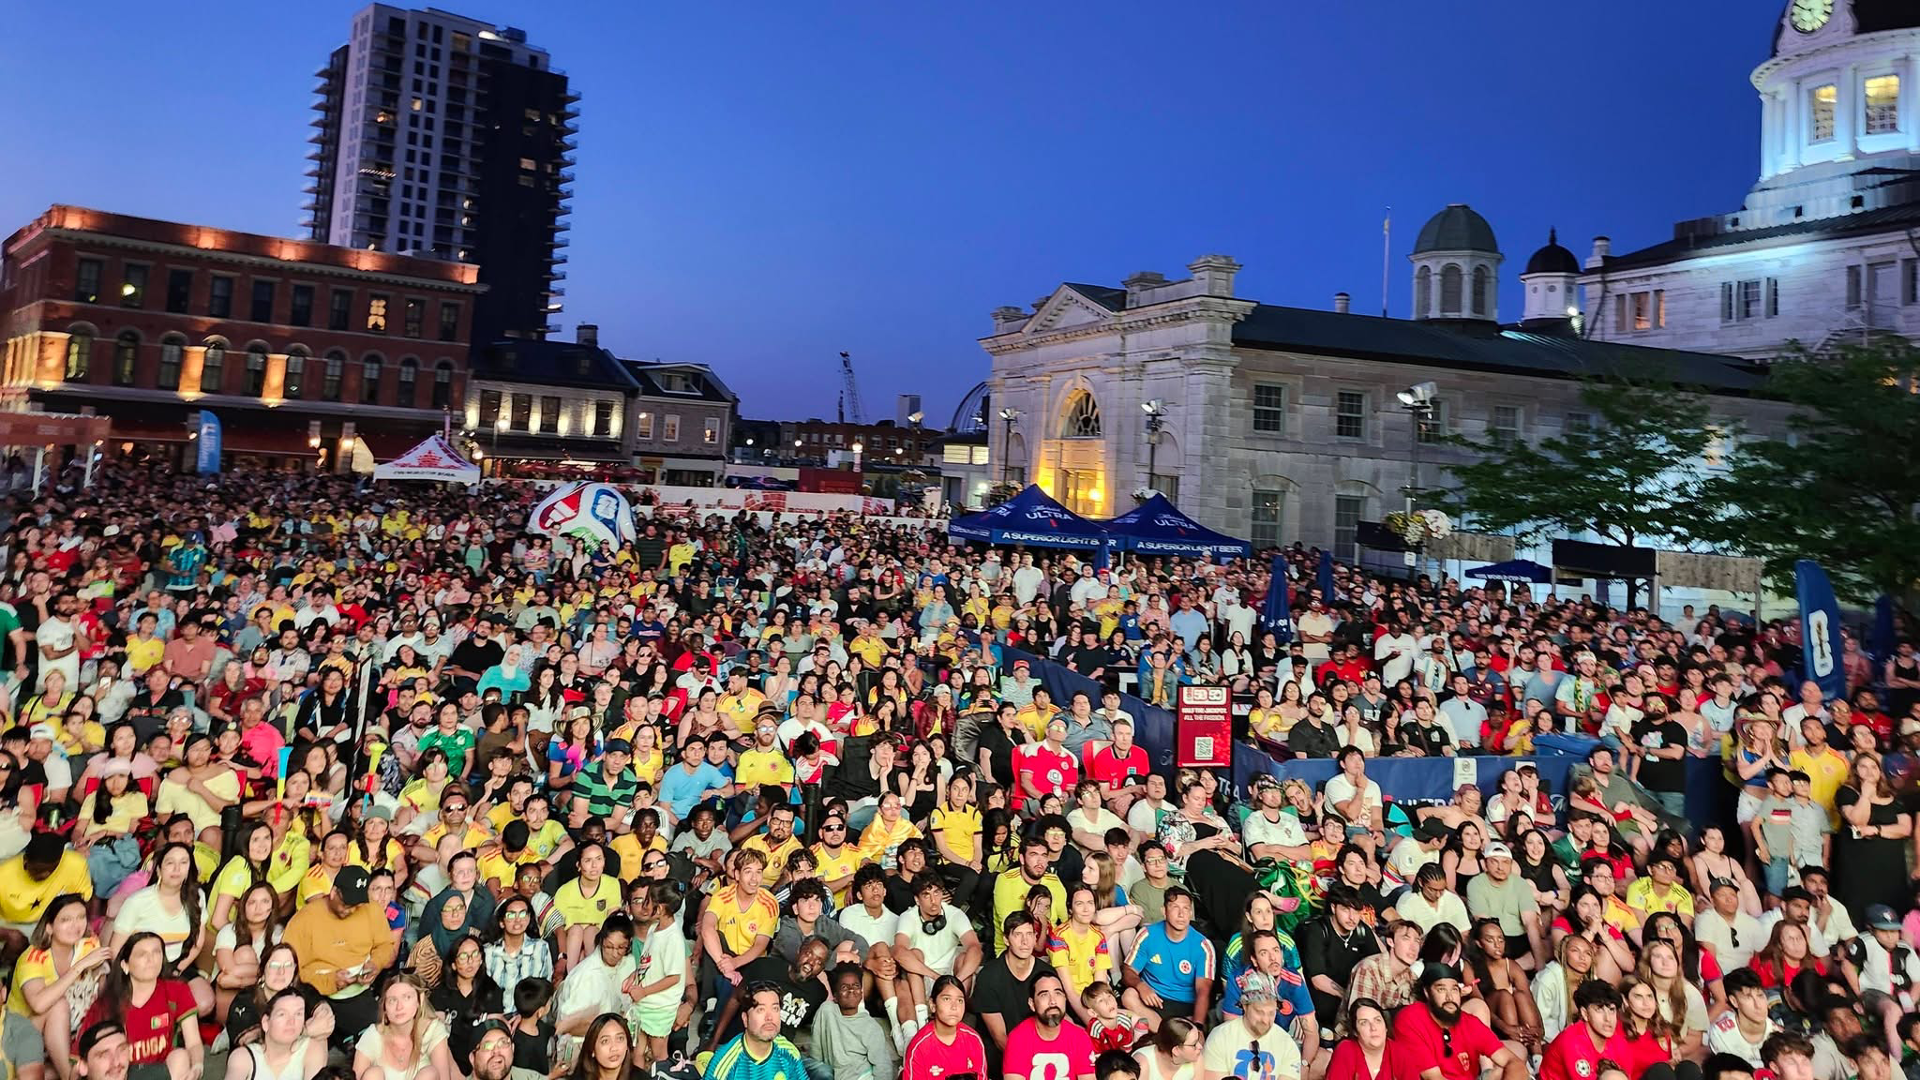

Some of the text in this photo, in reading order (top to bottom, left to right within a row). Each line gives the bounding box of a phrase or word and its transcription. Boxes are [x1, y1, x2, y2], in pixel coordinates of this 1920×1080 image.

[1025, 510, 1073, 521] ULTRA
[1153, 518, 1199, 531] ULTRA
[1011, 532, 1060, 543] SUPERIOR
[1061, 536, 1091, 545] LIGHT
[1091, 538, 1117, 547] BR
[1145, 542, 1191, 551] SUPERIOR
[1191, 544, 1218, 553] LIGHT
[1218, 545, 1243, 554] BEER
